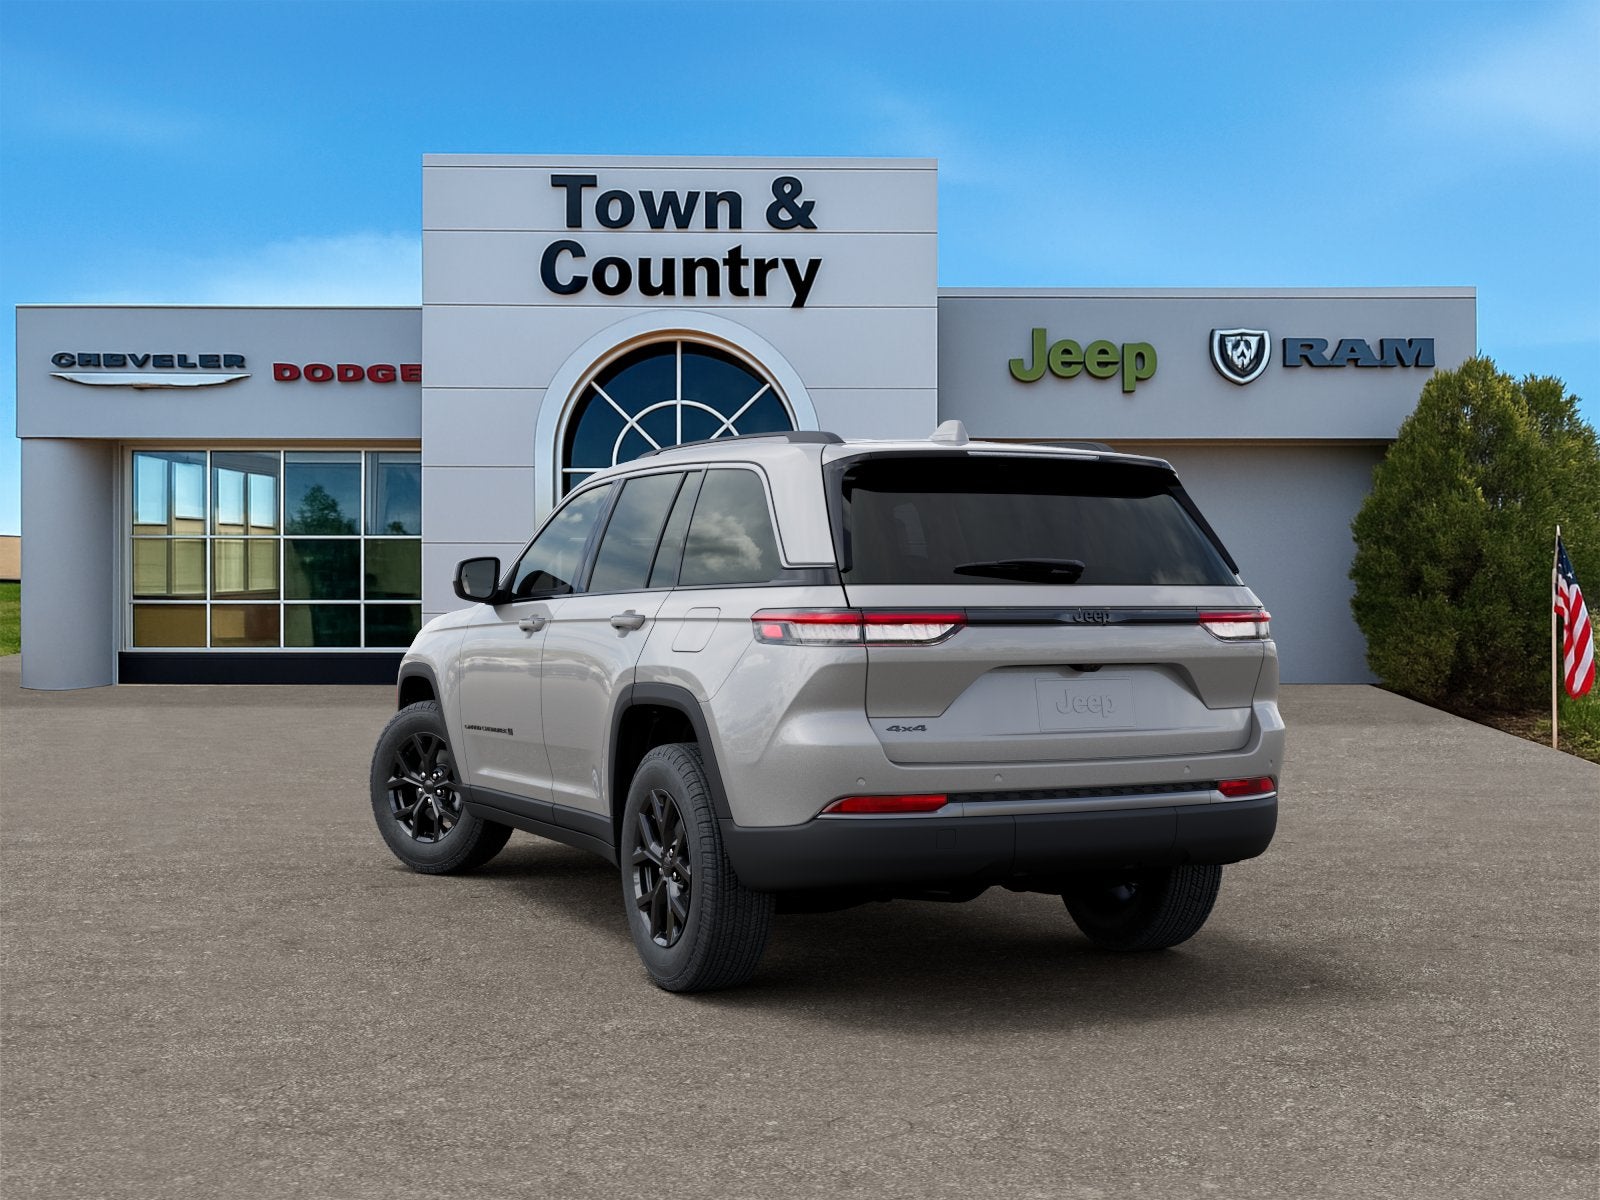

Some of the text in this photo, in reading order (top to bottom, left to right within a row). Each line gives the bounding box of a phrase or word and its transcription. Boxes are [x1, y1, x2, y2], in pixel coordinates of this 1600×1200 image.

[550, 173, 818, 230] Town &
[540, 239, 822, 308] Country
[1008, 327, 1157, 393] Jeep
[1282, 337, 1435, 368] RAM
[273, 362, 422, 383] DODGE
[1072, 608, 1111, 626] Jeep
[1055, 688, 1117, 720] Jeep
